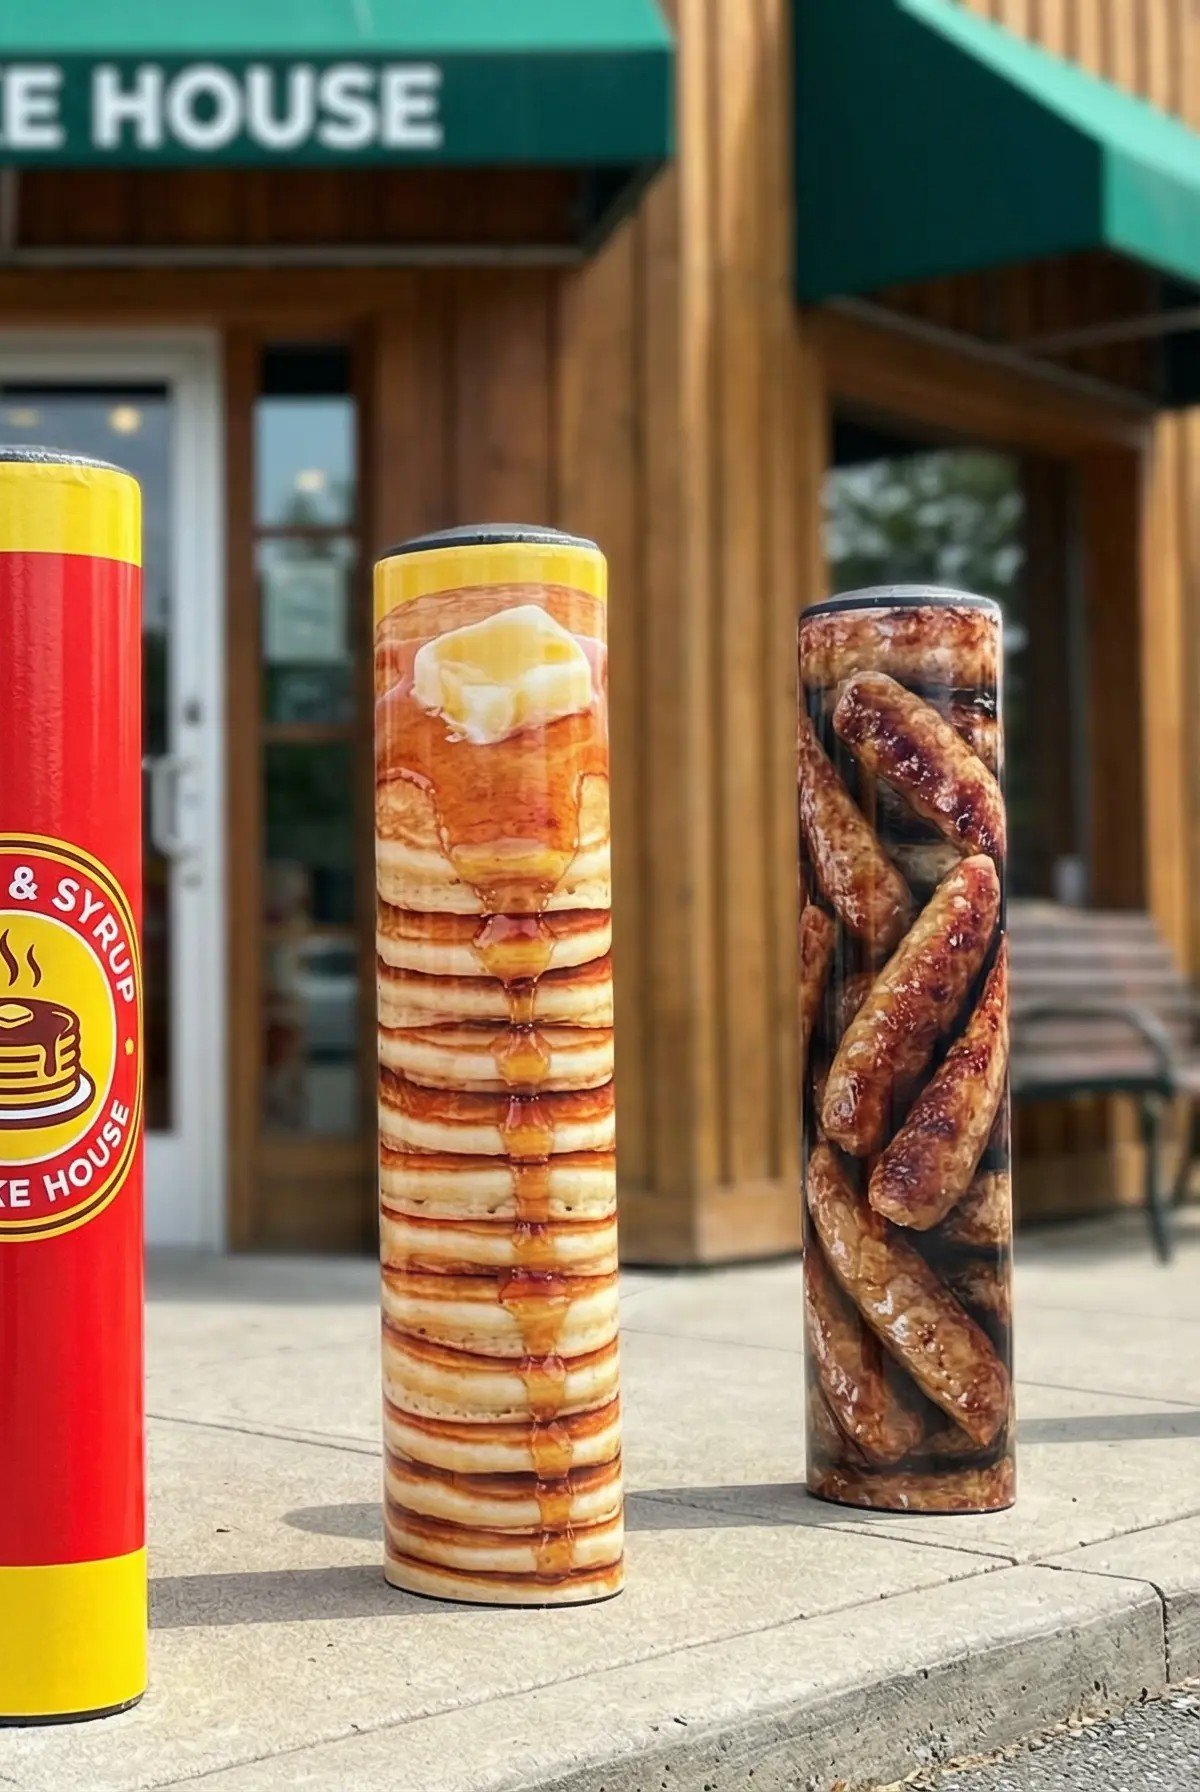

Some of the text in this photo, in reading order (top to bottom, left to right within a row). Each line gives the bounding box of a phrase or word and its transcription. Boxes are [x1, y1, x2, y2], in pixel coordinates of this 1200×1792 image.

[93, 64, 442, 149] HOUSE
[8, 866, 39, 900] &
[51, 877, 135, 1004] SYRUP
[43, 1099, 130, 1202] HOUSE
